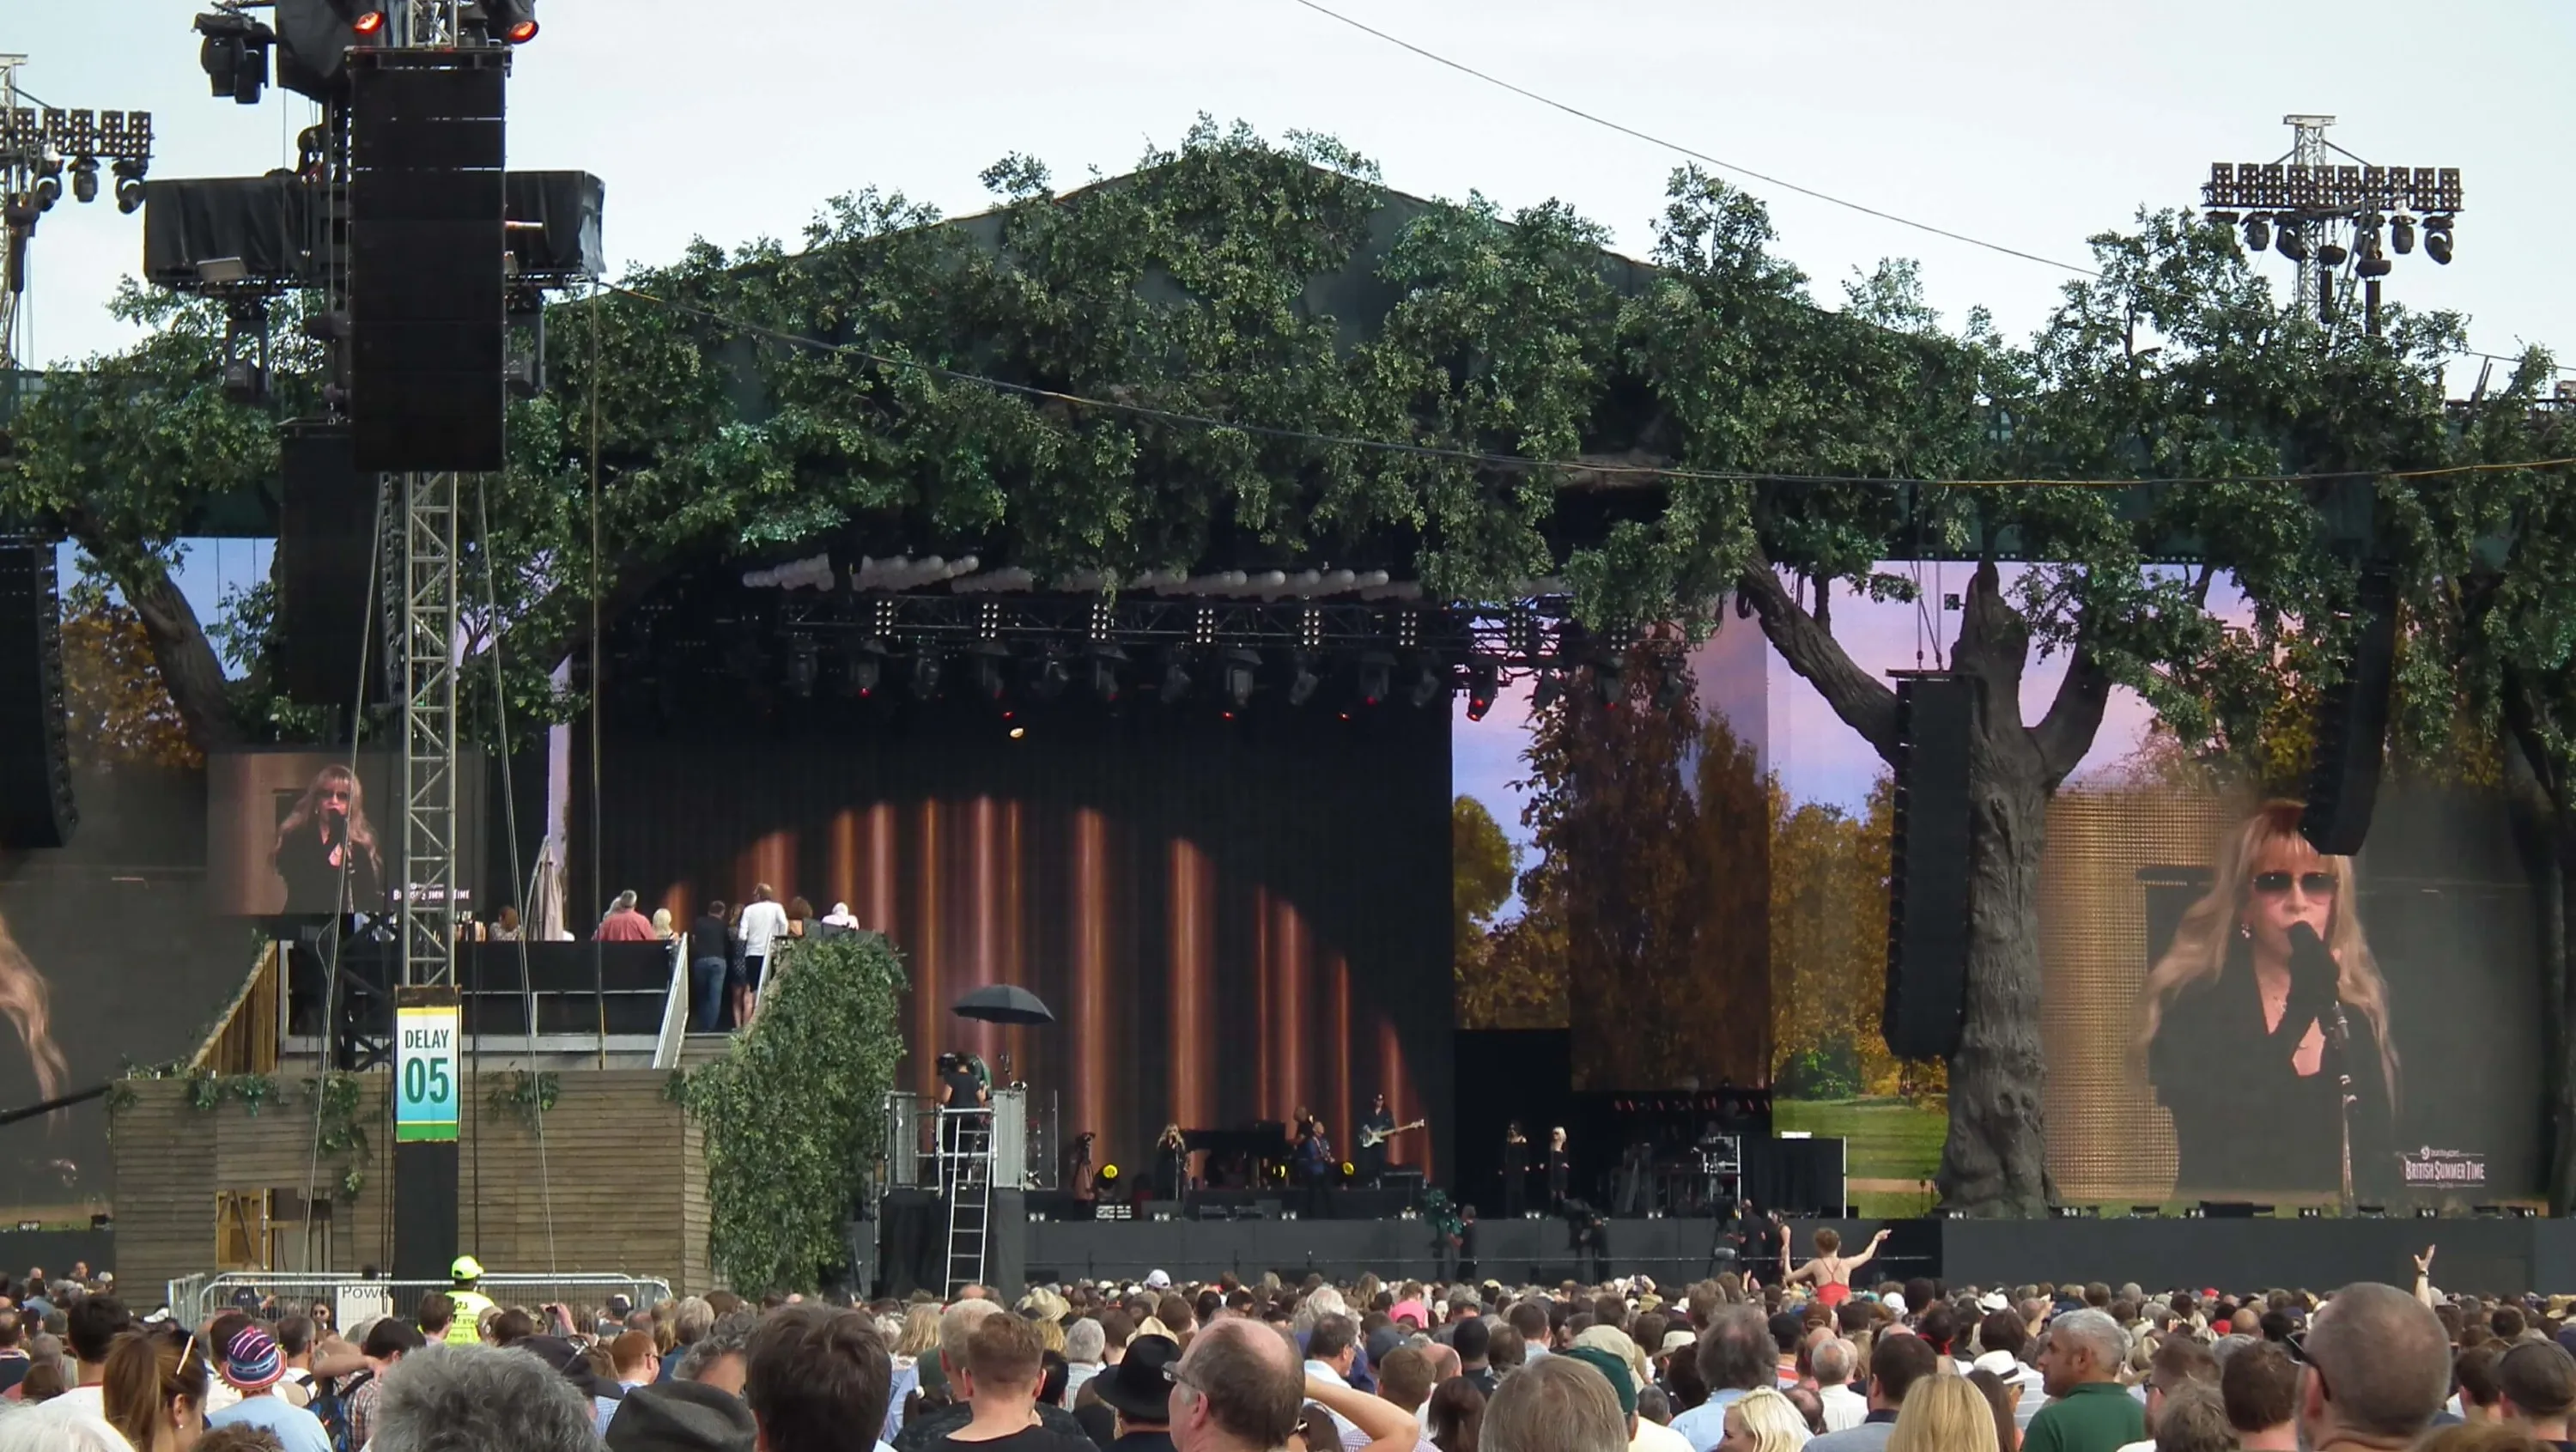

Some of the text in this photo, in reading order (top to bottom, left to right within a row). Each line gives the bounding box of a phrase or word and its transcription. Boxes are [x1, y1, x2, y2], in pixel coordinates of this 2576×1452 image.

[405, 1029, 449, 1048] DELAY
[405, 1056, 450, 1104] 05
[2405, 1160, 2485, 1180] BRITISH SUMMER TIME
